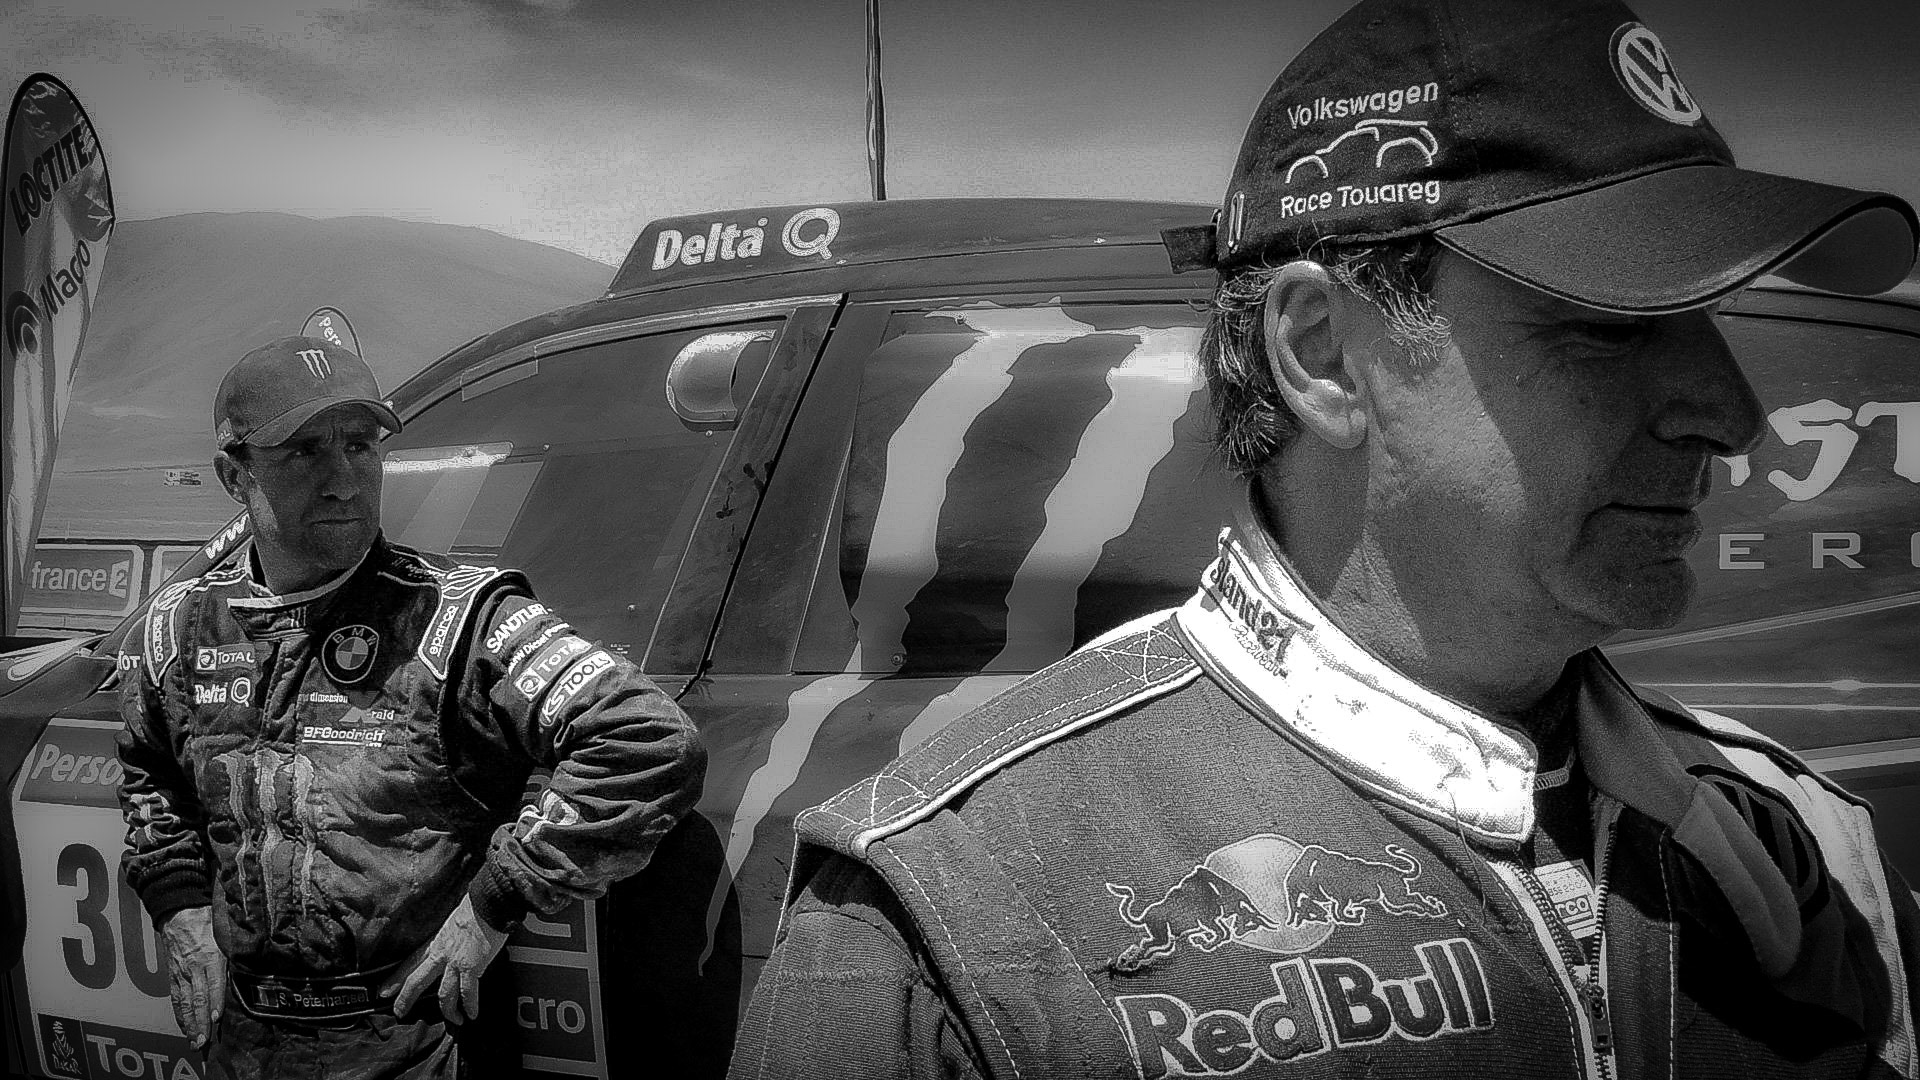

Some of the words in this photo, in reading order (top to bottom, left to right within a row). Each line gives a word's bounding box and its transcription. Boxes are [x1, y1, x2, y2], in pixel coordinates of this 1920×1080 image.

[1287, 82, 1439, 130] Volkswagen
[10, 122, 90, 237] LOCTITE
[1281, 192, 1333, 219] Race
[1336, 180, 1441, 208] Touareg
[651, 217, 768, 271] Delta
[781, 207, 842, 260] Q
[1718, 531, 1920, 570] ER
[31, 561, 107, 591] france
[486, 603, 549, 654] SANDTLER
[217, 651, 255, 664] TOTAL
[231, 677, 250, 708] Q
[303, 726, 385, 742] BFGoodrich
[31, 743, 126, 786] Perso
[57, 843, 171, 999] 30
[517, 996, 586, 1034] cro
[1115, 958, 1331, 1080] Red
[1308, 937, 1496, 1049] Bull
